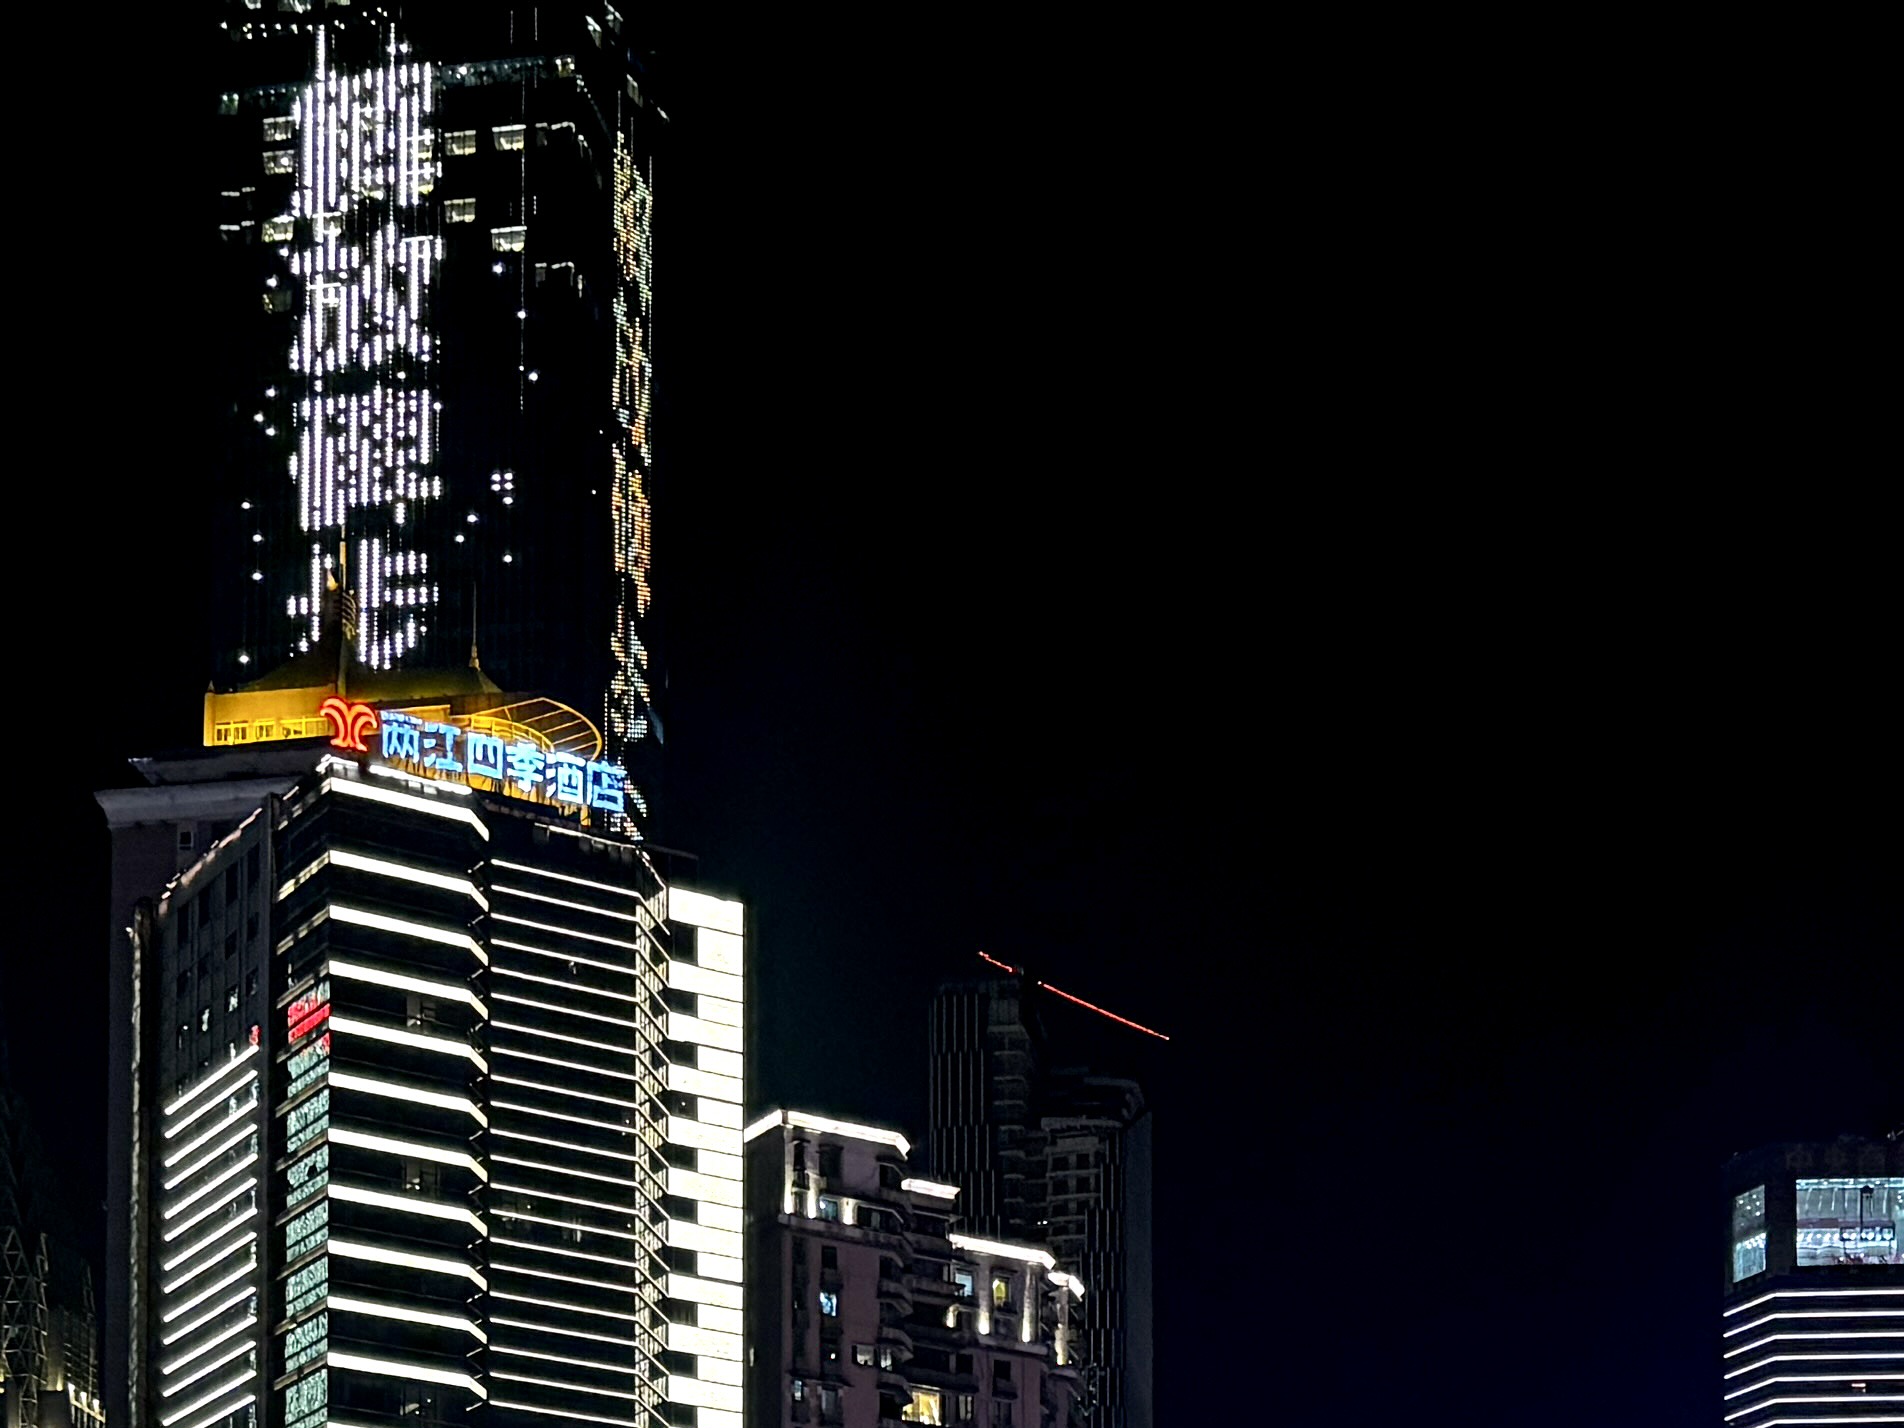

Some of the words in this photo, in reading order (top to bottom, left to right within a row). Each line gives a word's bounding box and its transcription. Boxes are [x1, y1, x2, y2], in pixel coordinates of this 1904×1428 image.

[381, 710, 626, 812] 两江四季酒店
